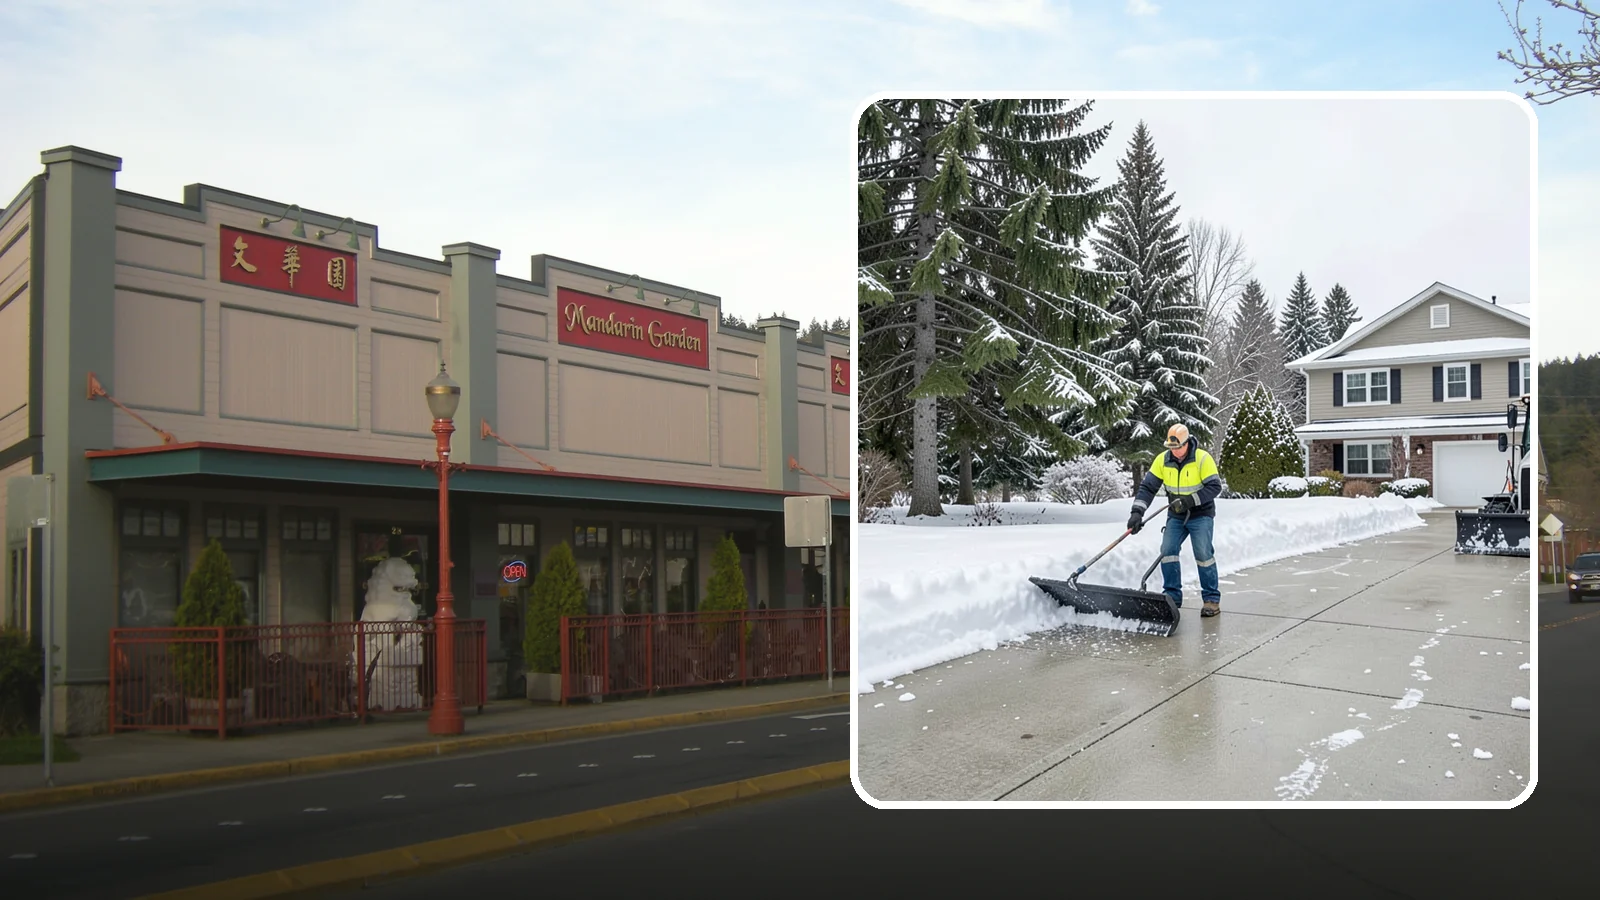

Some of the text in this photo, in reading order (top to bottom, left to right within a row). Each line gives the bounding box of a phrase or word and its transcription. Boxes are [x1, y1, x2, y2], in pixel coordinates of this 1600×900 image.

[231, 235, 346, 291] 文華園
[564, 302, 702, 352] Mandarin Garden
[503, 565, 527, 579] OPEN
